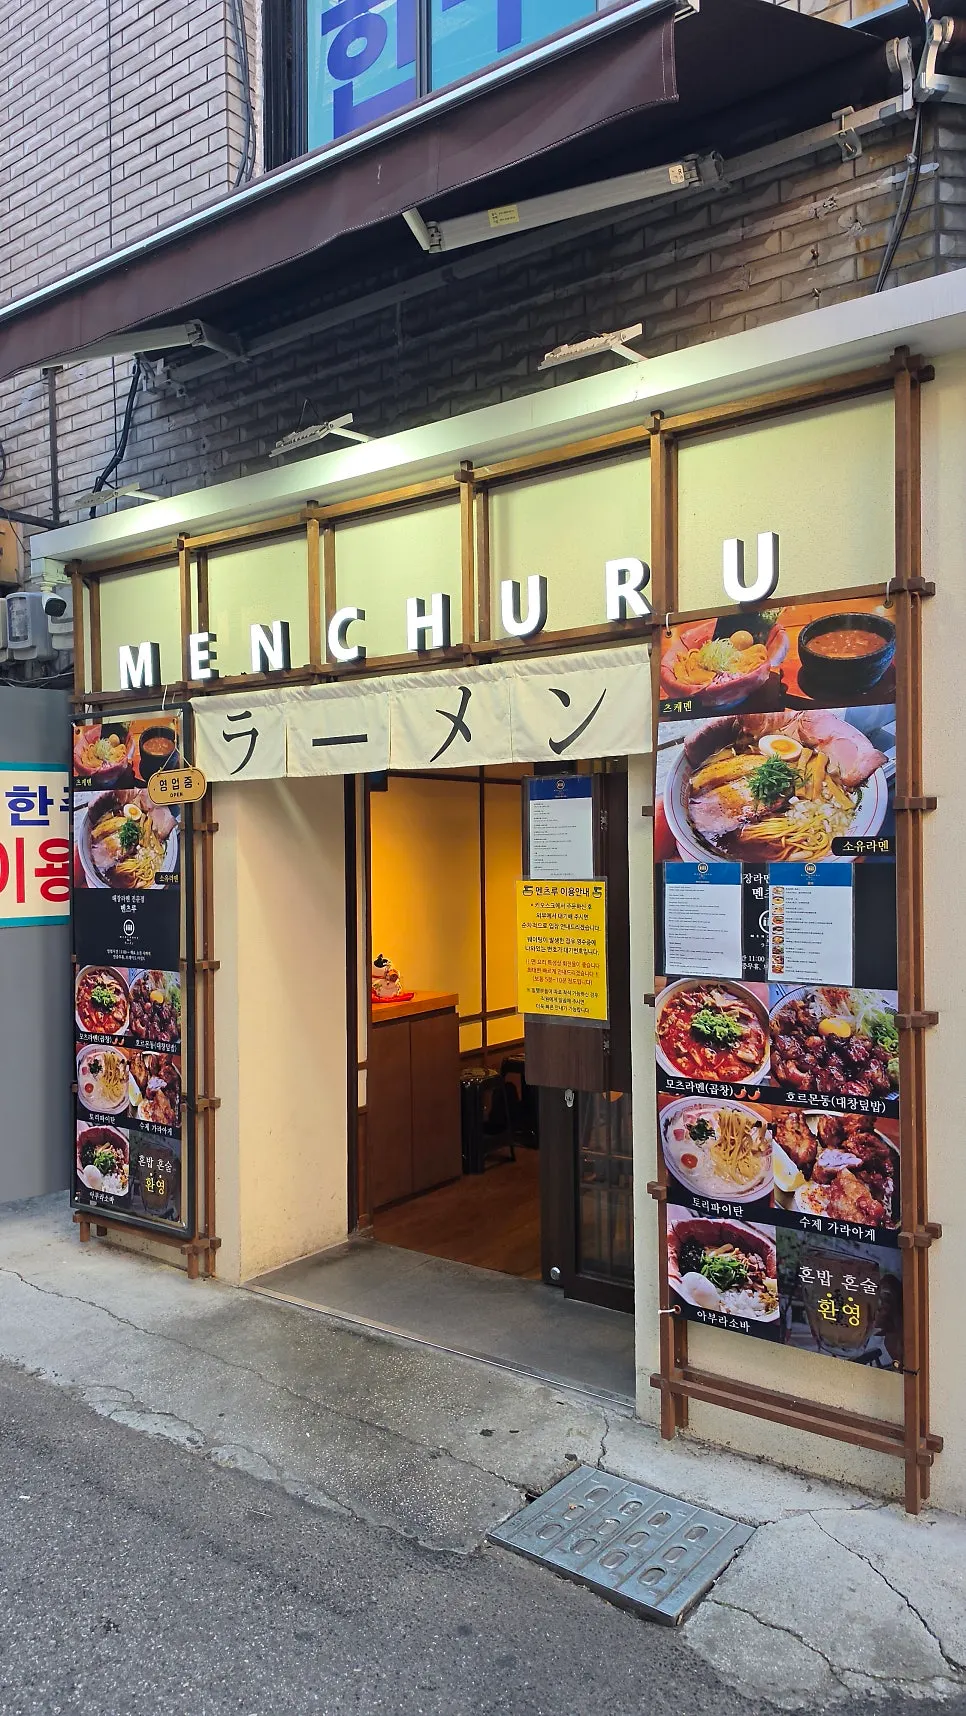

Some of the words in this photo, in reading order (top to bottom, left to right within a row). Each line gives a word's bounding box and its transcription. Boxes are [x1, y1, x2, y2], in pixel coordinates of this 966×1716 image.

[119, 531, 780, 691] MENCHURU
[663, 701, 692, 714] 츠케멘
[222, 685, 608, 776] ラーメン
[842, 839, 890, 853] 소유라멘
[535, 886, 558, 896] 멘츠루
[560, 887, 590, 897] 이용안내
[665, 1079, 734, 1097] 모츠라멘(곱창)
[785, 1091, 887, 1113] 호르몬동(대창덮밥)
[138, 1155, 154, 1169] 혼밥
[145, 1176, 166, 1195] 환영
[691, 1197, 744, 1218] 토리파이탄
[799, 1216, 822, 1233] 수제
[826, 1221, 876, 1242] 가라아게
[798, 1265, 834, 1287] 혼밥
[841, 1273, 879, 1296] 혼술
[696, 1310, 750, 1333] 아부라소바
[817, 1297, 861, 1327] 환영
